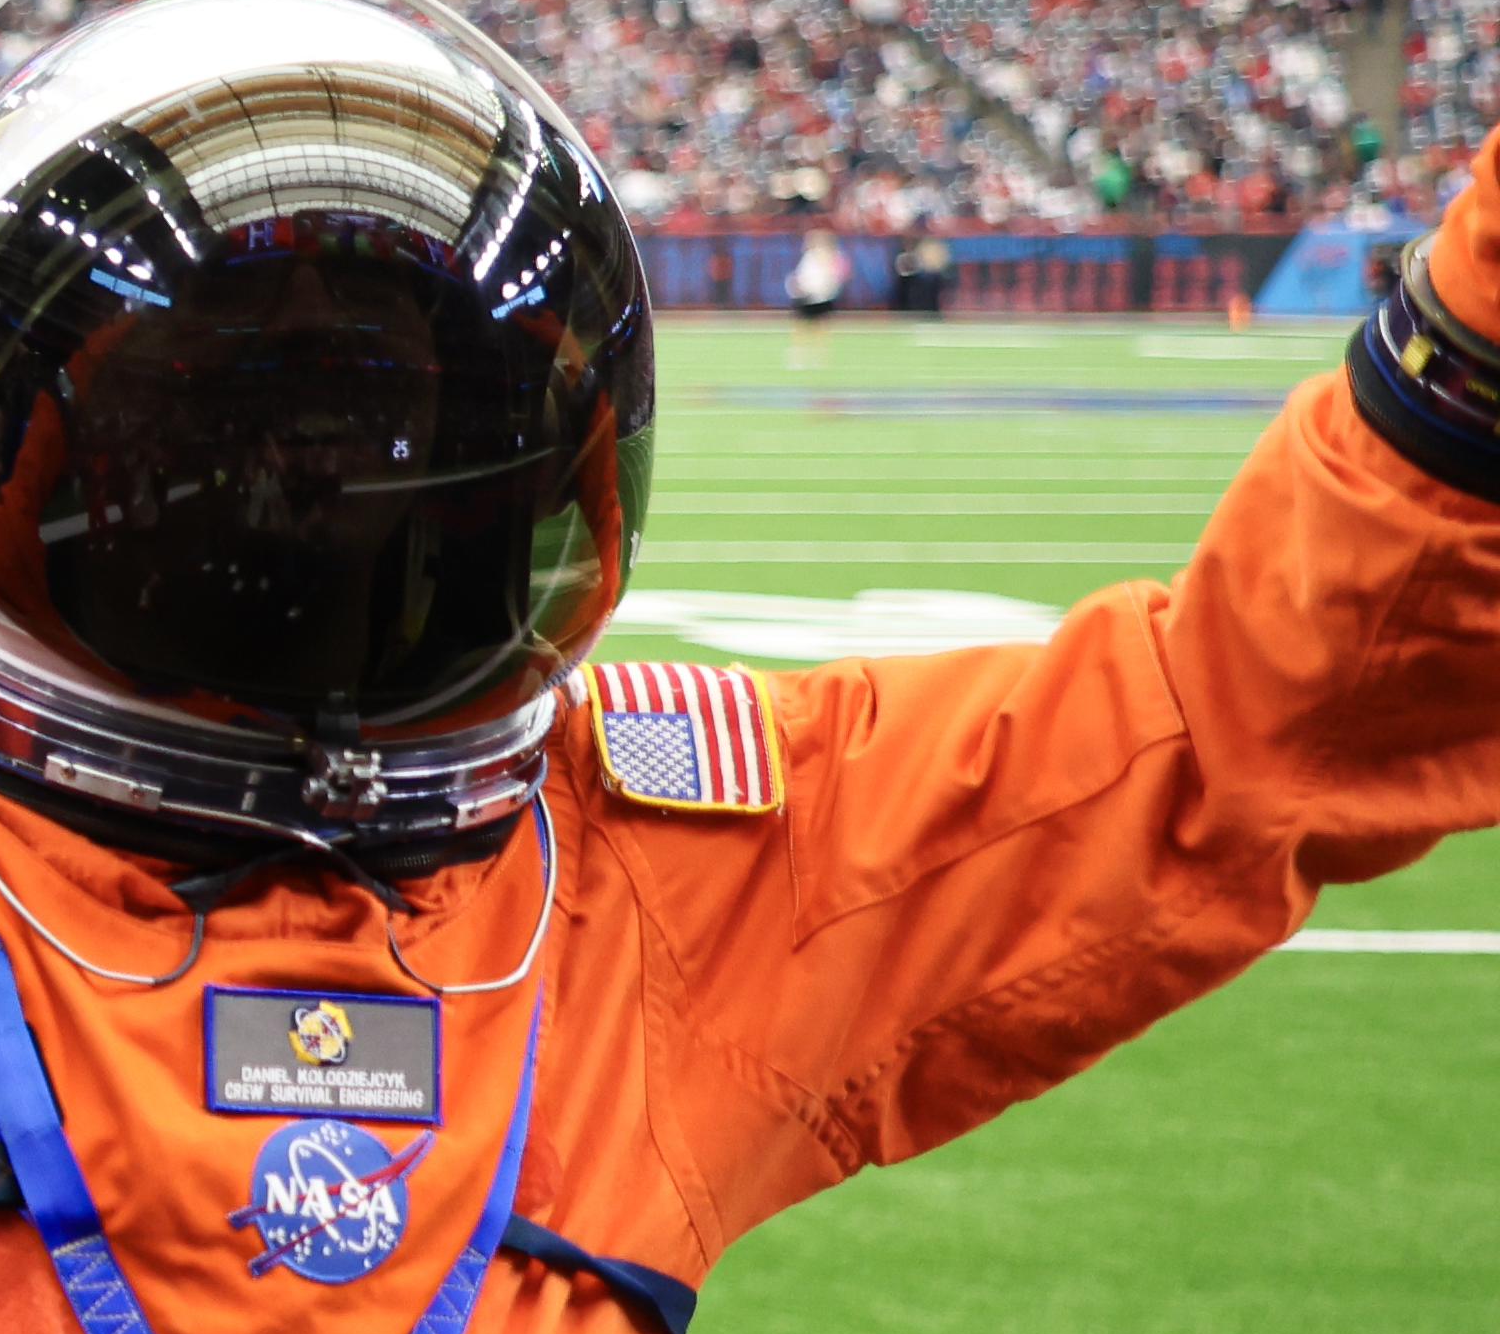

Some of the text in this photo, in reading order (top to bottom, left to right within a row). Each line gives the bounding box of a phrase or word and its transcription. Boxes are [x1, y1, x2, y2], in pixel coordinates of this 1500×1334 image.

[241, 1066, 291, 1084] DANIEL
[224, 1082, 425, 1108] CREW SURVIVAL ENGINEERING
[263, 1171, 400, 1225] NASA
